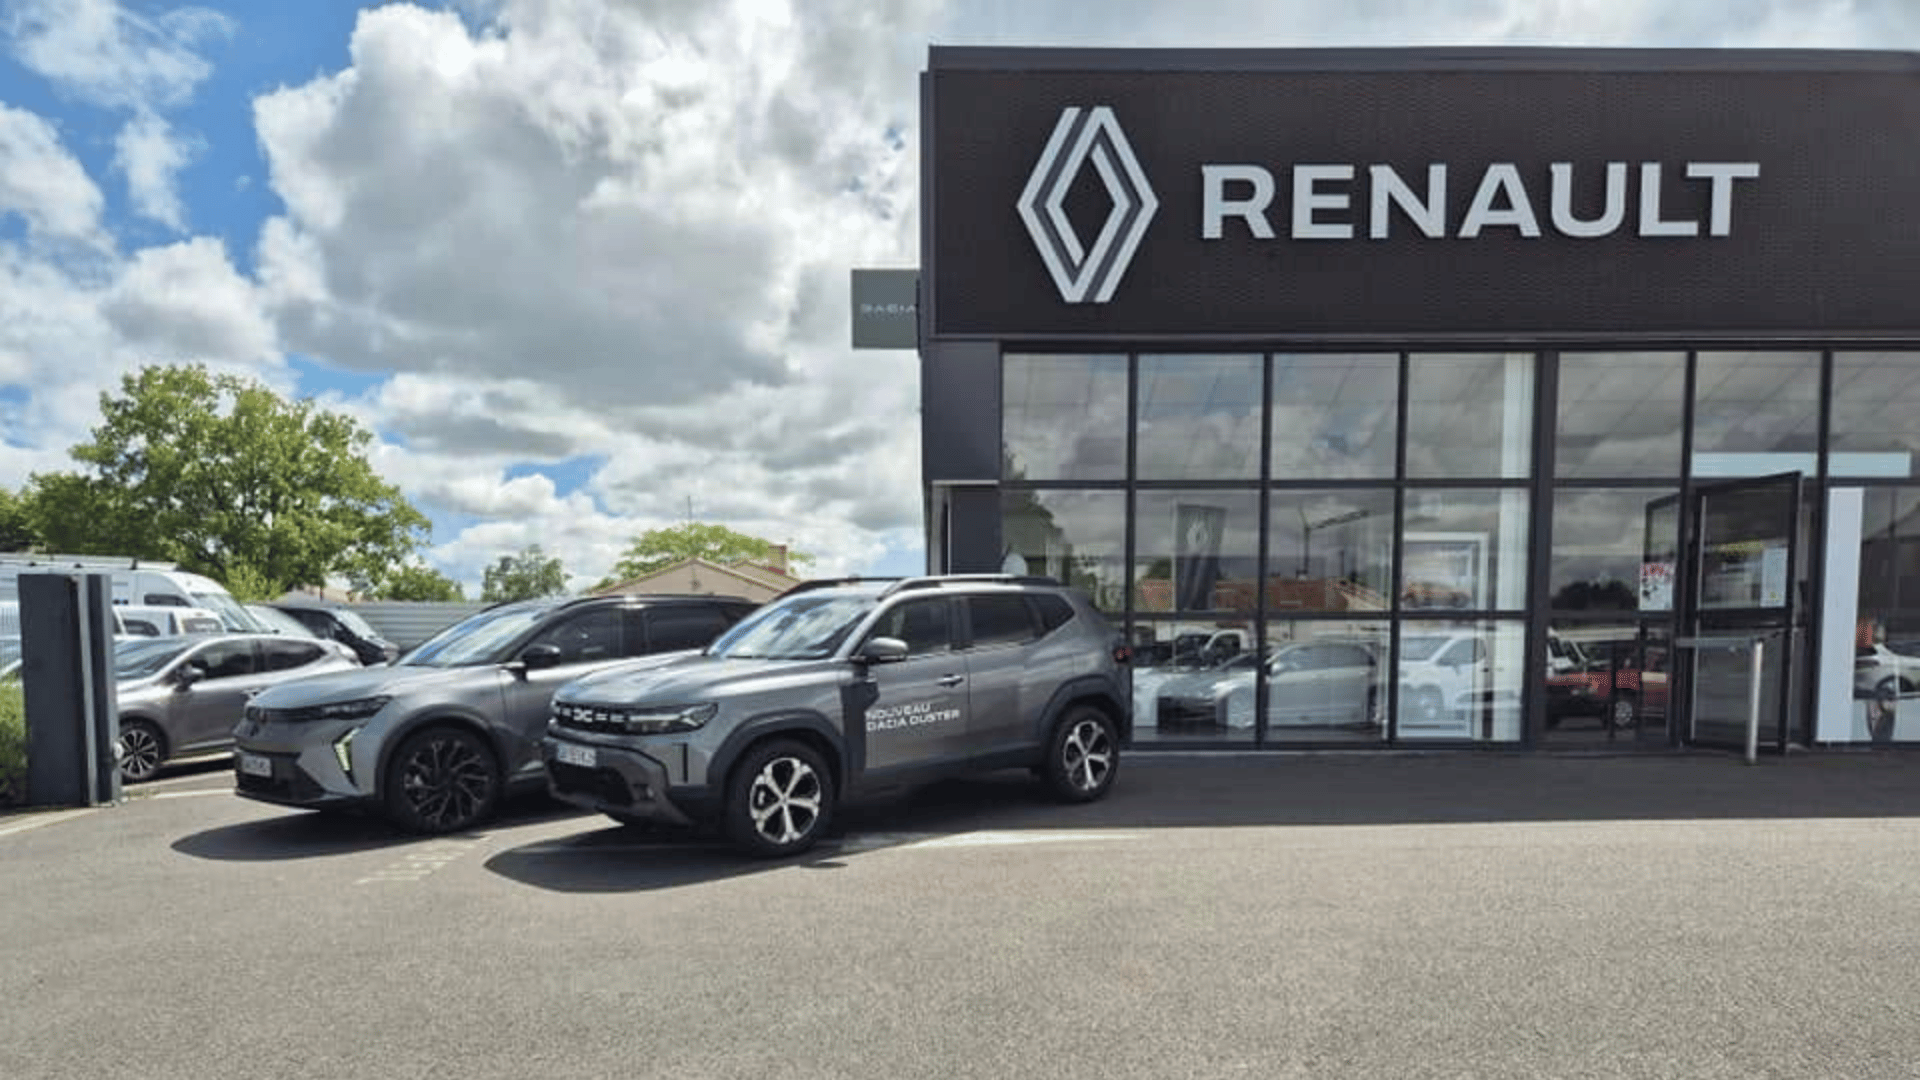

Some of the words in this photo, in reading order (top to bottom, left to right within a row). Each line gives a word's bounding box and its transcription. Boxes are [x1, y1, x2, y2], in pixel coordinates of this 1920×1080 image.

[1201, 161, 1760, 239] RENAULT
[865, 702, 932, 720] NOUVEAU
[866, 717, 907, 732] DACIA
[909, 709, 960, 726] DUSTER
